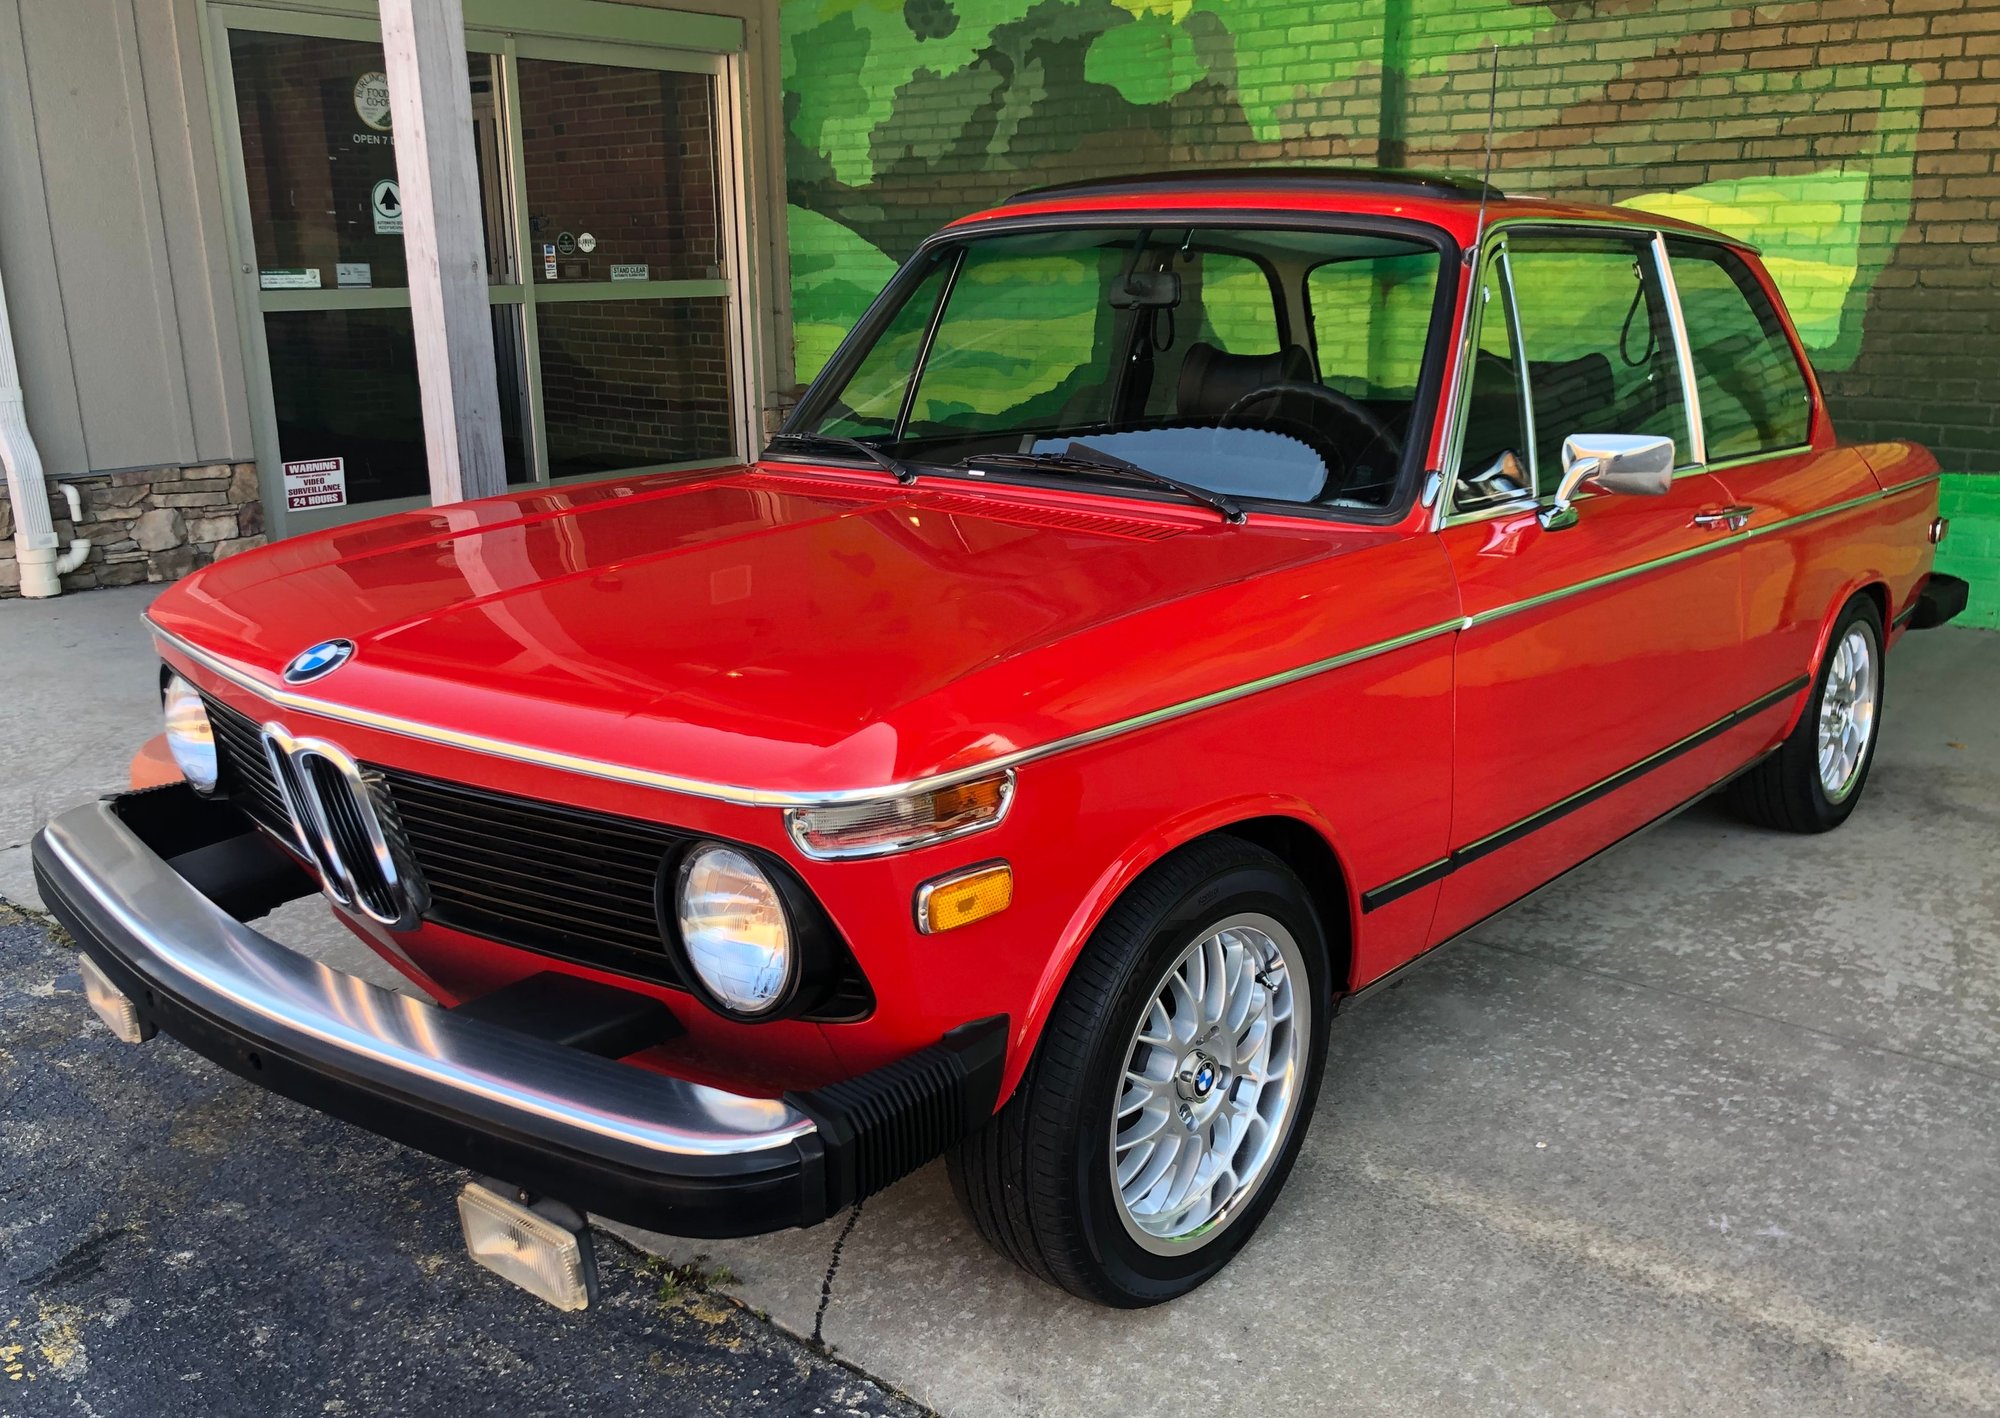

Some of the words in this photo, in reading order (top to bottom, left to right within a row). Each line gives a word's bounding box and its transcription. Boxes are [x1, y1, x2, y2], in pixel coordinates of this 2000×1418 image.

[367, 88, 389, 98] FOOD
[353, 133, 380, 145] OPEN
[382, 136, 388, 145] 7
[630, 266, 646, 274] CLEAR
[289, 461, 337, 474] WARNING
[303, 477, 325, 486] VIDEO
[288, 483, 341, 496] SURVEILLANCE
[293, 497, 306, 507] 24
[308, 493, 339, 505] HOURS
